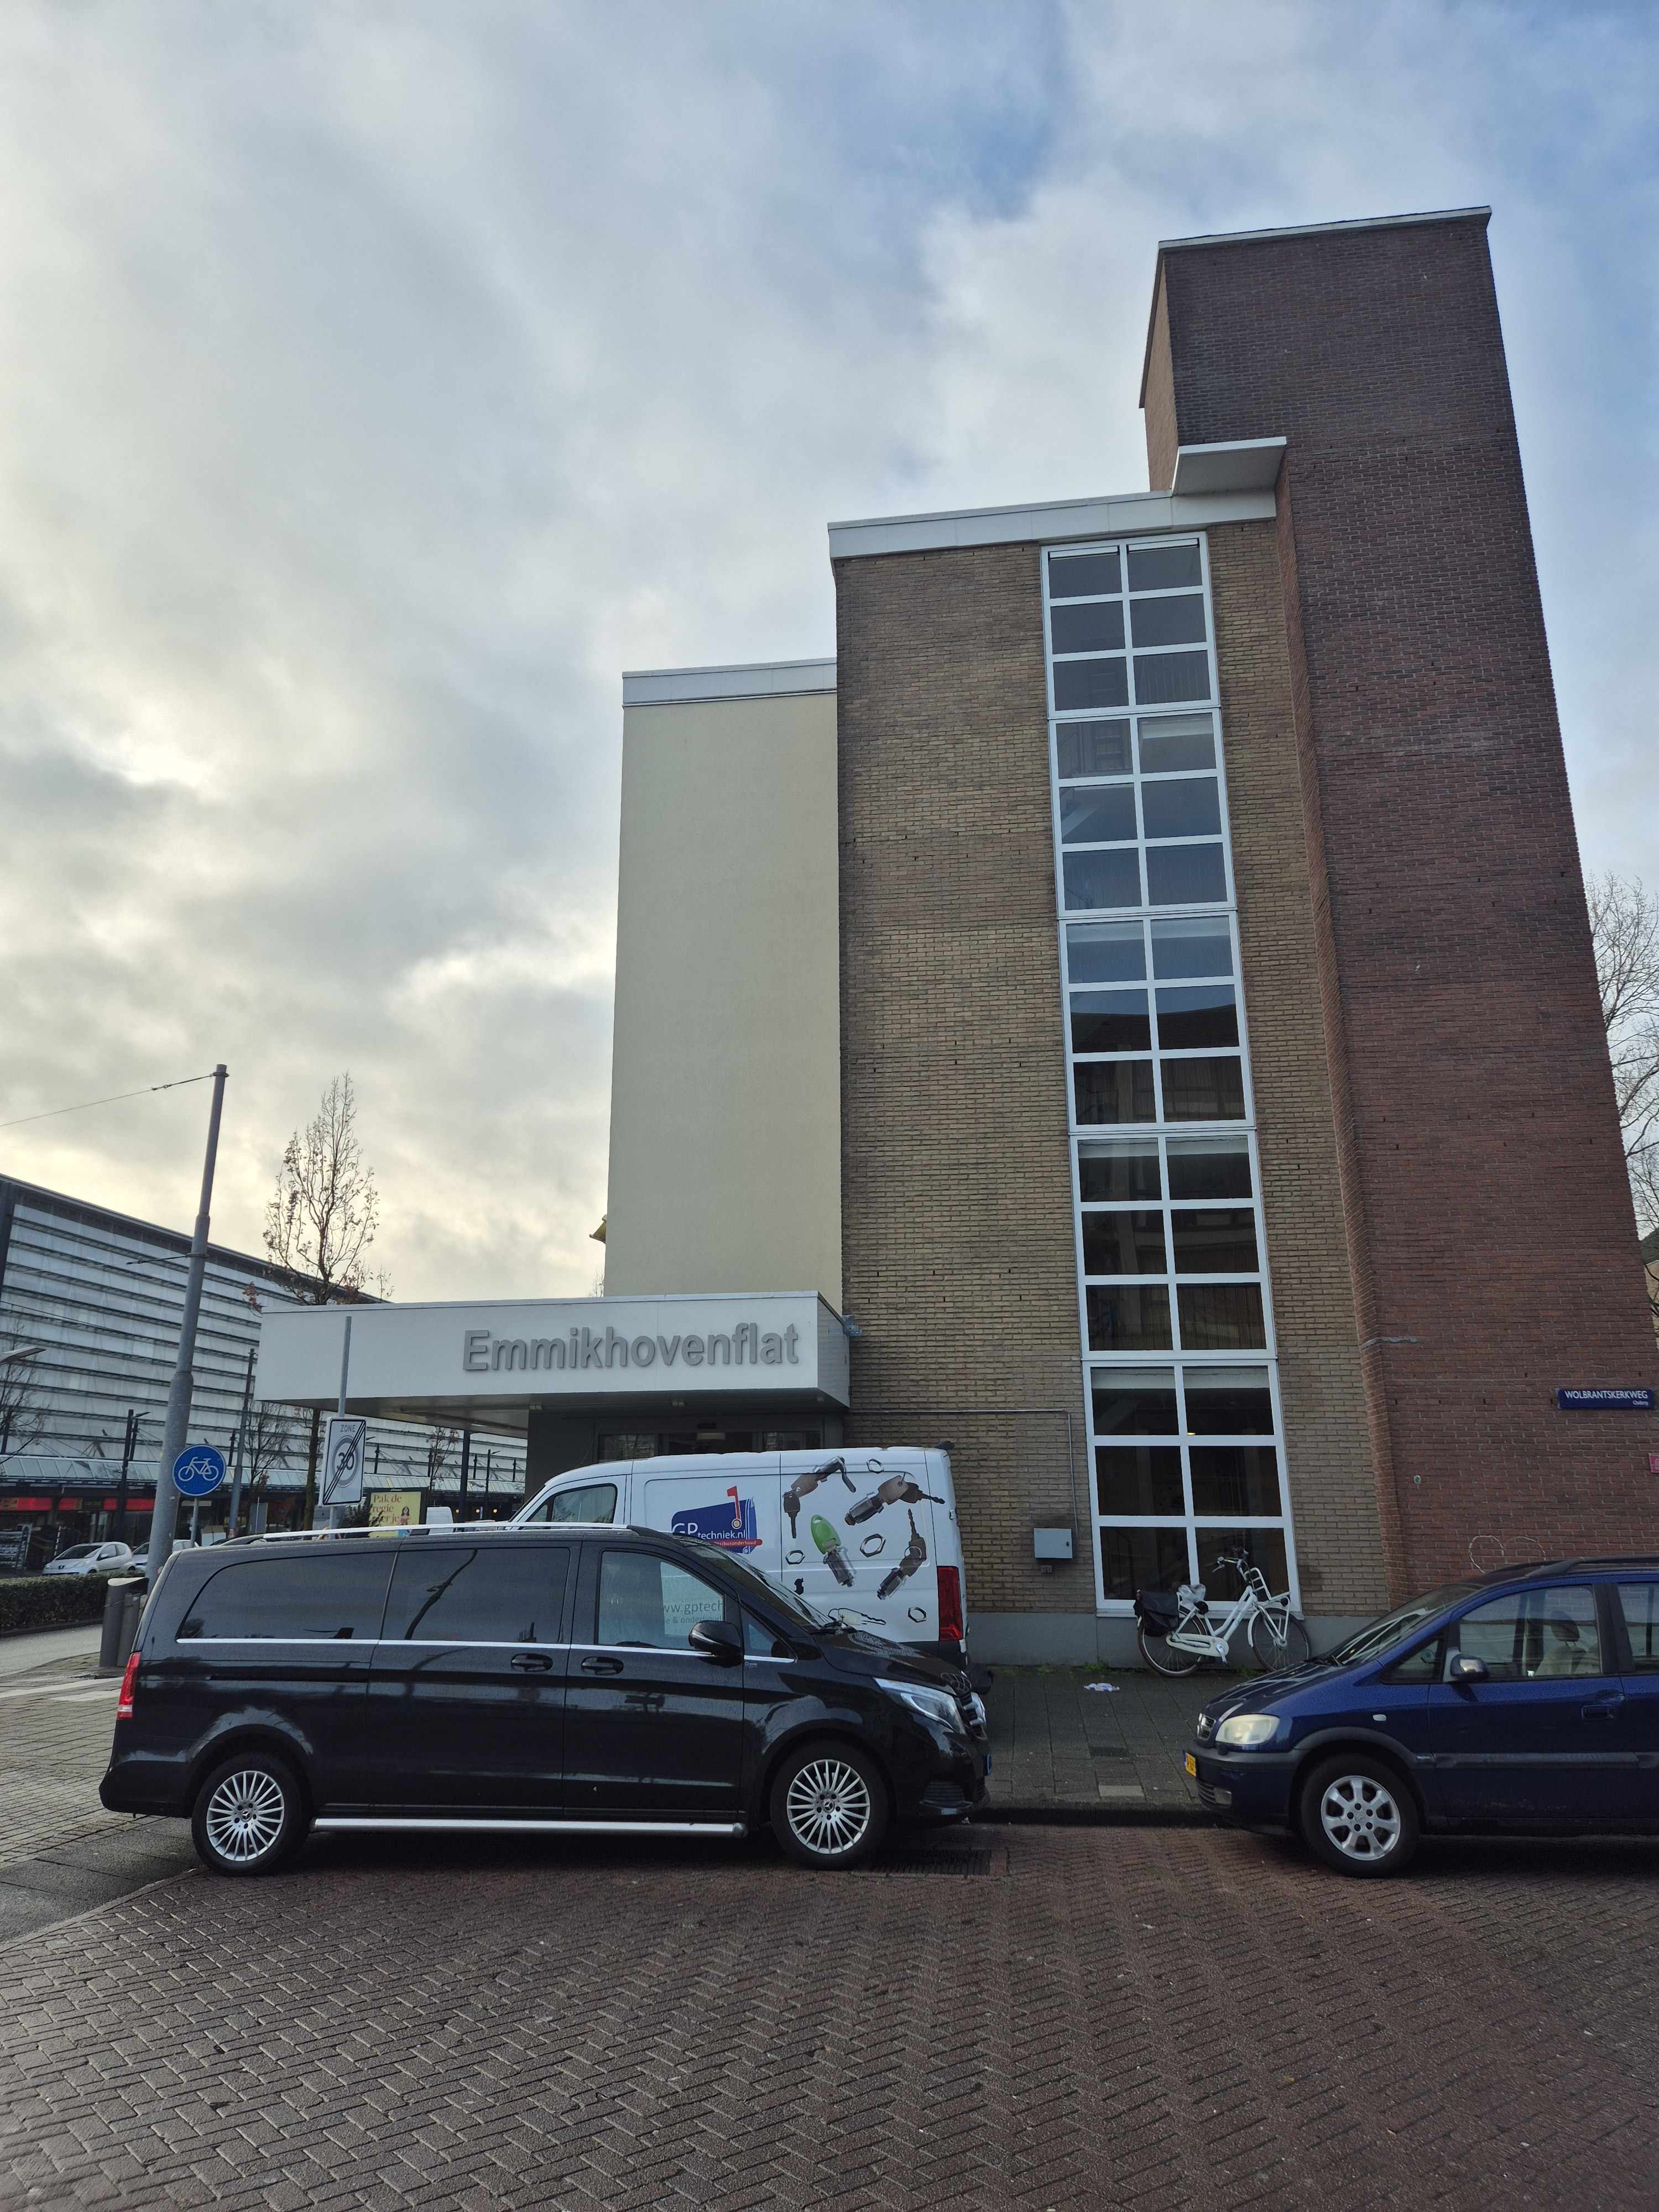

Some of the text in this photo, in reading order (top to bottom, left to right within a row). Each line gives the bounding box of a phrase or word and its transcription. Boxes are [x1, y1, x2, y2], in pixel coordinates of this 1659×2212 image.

[463, 1322, 799, 1371] Emmikhovenflat
[1564, 1390, 1648, 1399] WOLBRANTSKERKWEG
[340, 1424, 356, 1432] ZONE
[336, 1452, 354, 1470] 30
[373, 1494, 402, 1503] Pak de
[372, 1504, 394, 1513] regie
